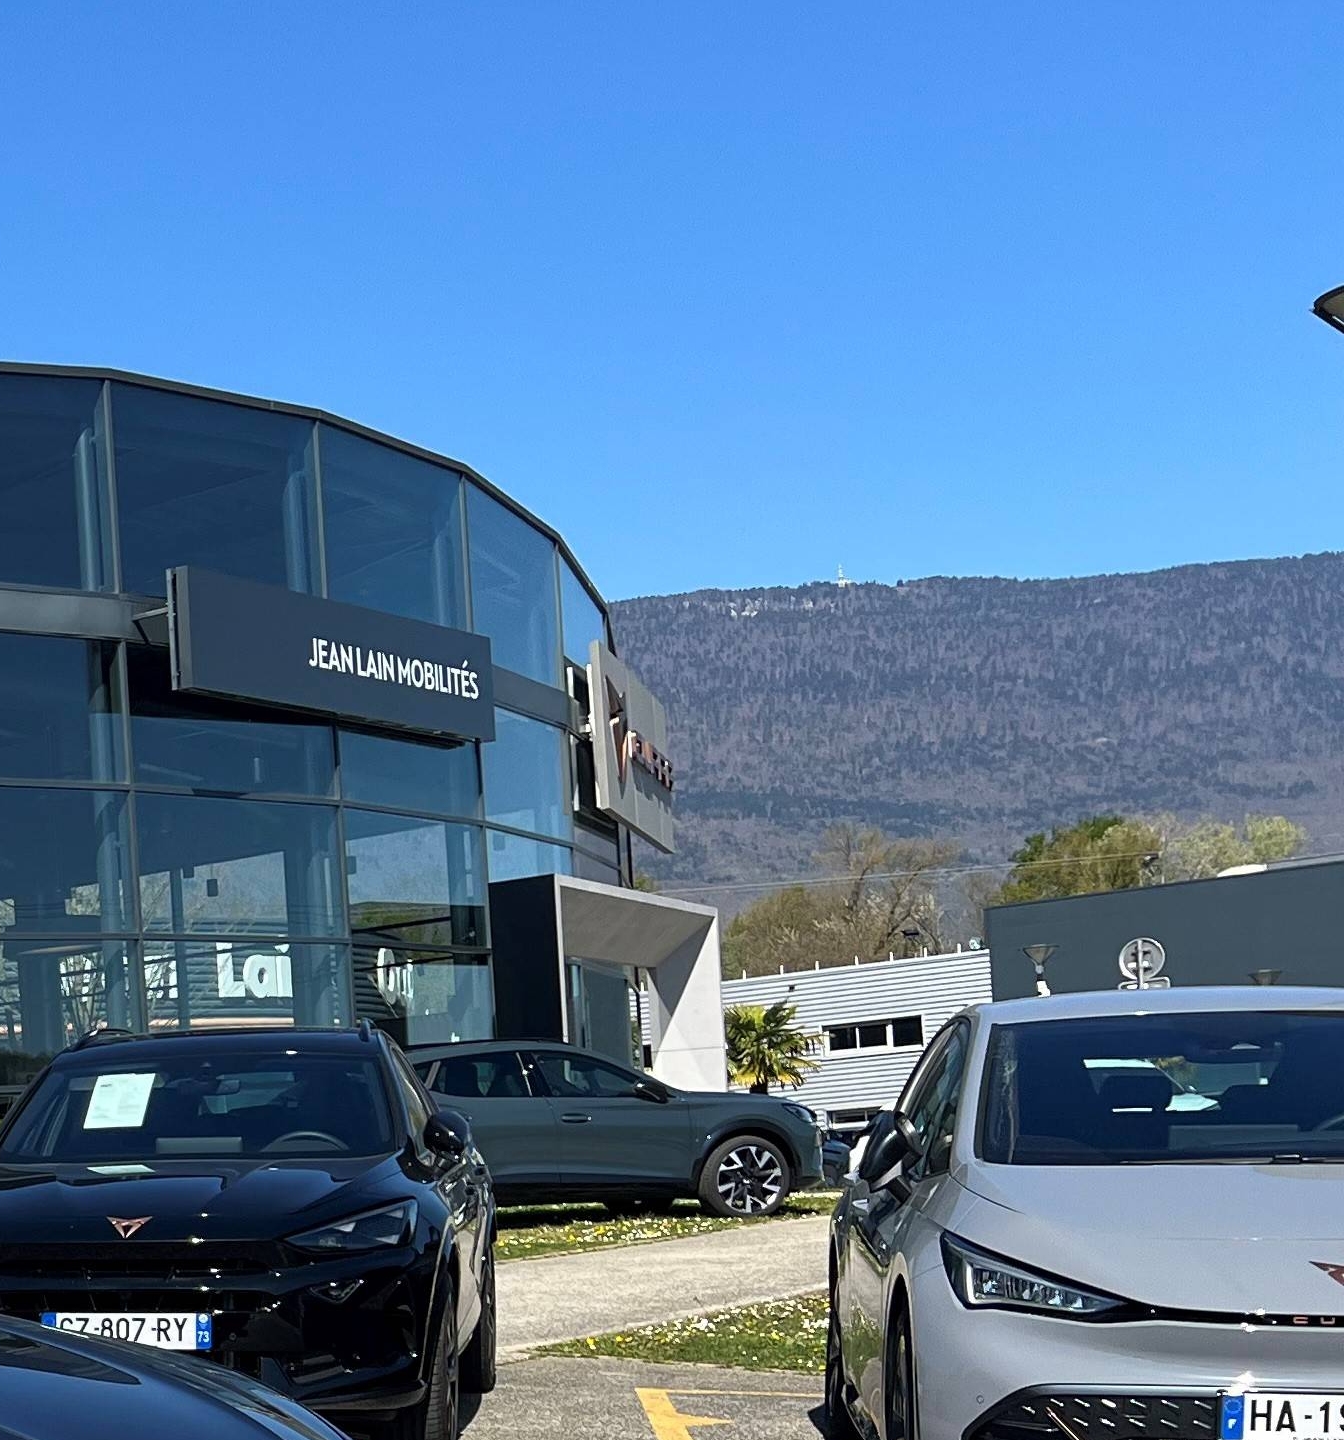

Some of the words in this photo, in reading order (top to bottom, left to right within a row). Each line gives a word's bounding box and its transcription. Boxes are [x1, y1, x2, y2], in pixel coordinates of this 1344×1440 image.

[309, 637, 354, 674] JEAN
[355, 647, 395, 682] LAIN
[397, 655, 480, 700] MOBILITÉS
[215, 942, 293, 998] Lai
[197, 1330, 210, 1343] 73
[1250, 1399, 1344, 1433] HA-1
